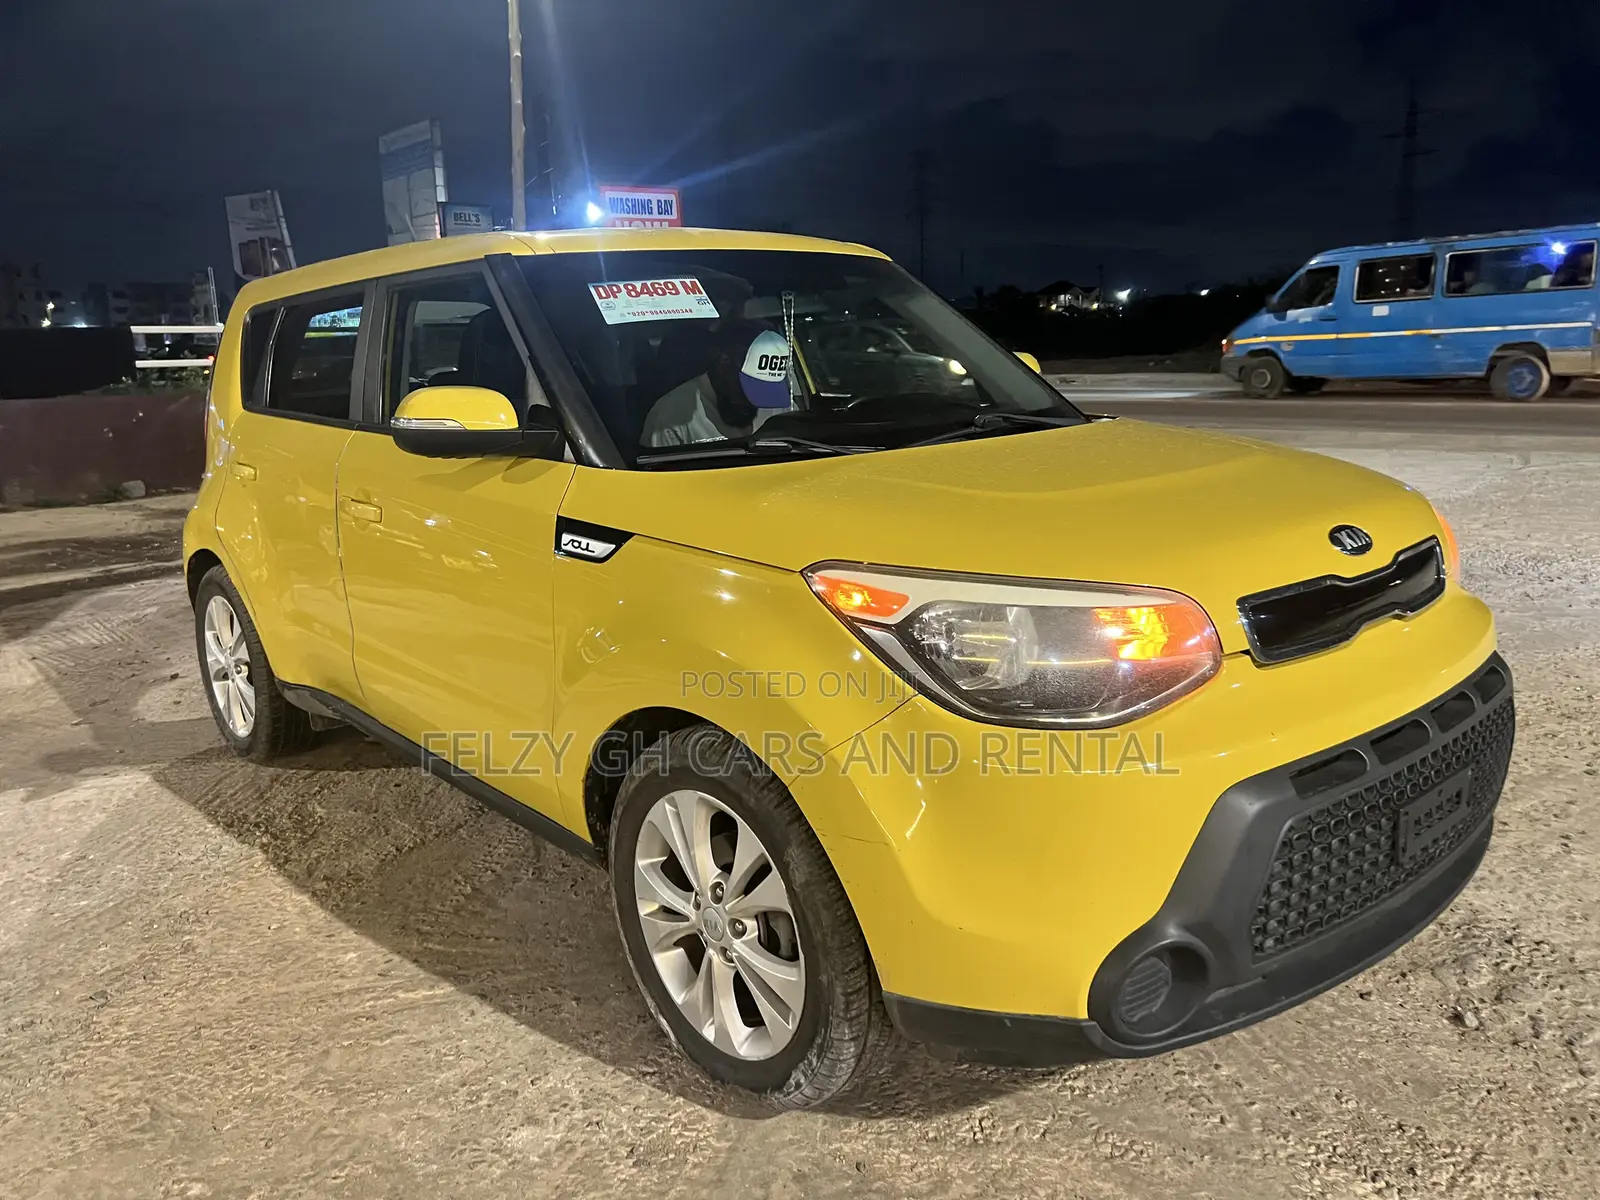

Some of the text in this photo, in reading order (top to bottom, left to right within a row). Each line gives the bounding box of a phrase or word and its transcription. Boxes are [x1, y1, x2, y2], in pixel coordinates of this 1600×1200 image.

[608, 197, 673, 216] WASHING BAY
[453, 211, 481, 223] BELL'S
[593, 281, 704, 298] DP 8469 M
